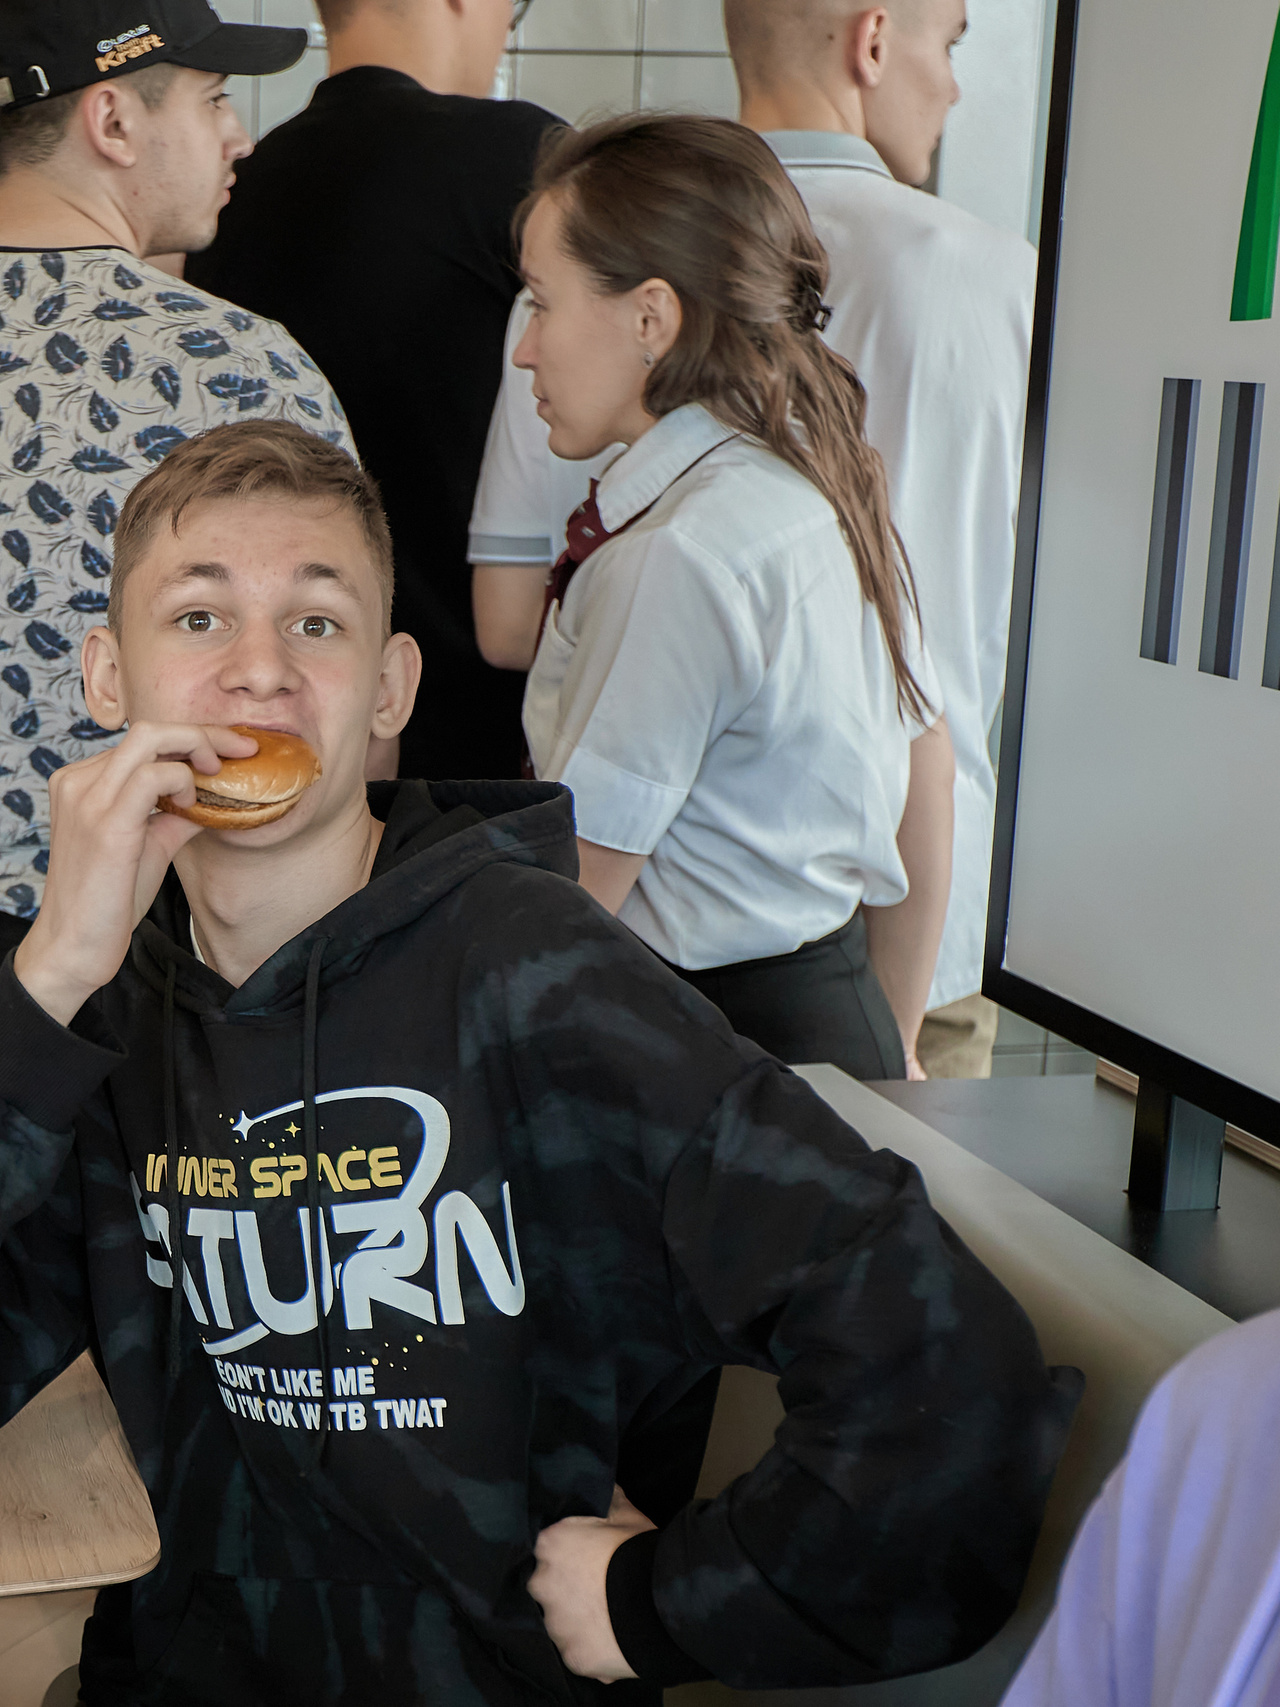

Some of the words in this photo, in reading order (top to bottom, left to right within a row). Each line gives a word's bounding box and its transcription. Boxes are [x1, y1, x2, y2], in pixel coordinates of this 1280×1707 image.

[95, 34, 166, 73] Kraft
[250, 1146, 403, 1198] SPACE
[269, 1367, 324, 1397] LIKE
[332, 1366, 376, 1397] ME
[236, 1393, 266, 1423] I'M
[266, 1398, 299, 1429] OK
[299, 1401, 367, 1432] WTB
[372, 1398, 447, 1430] TWAT
